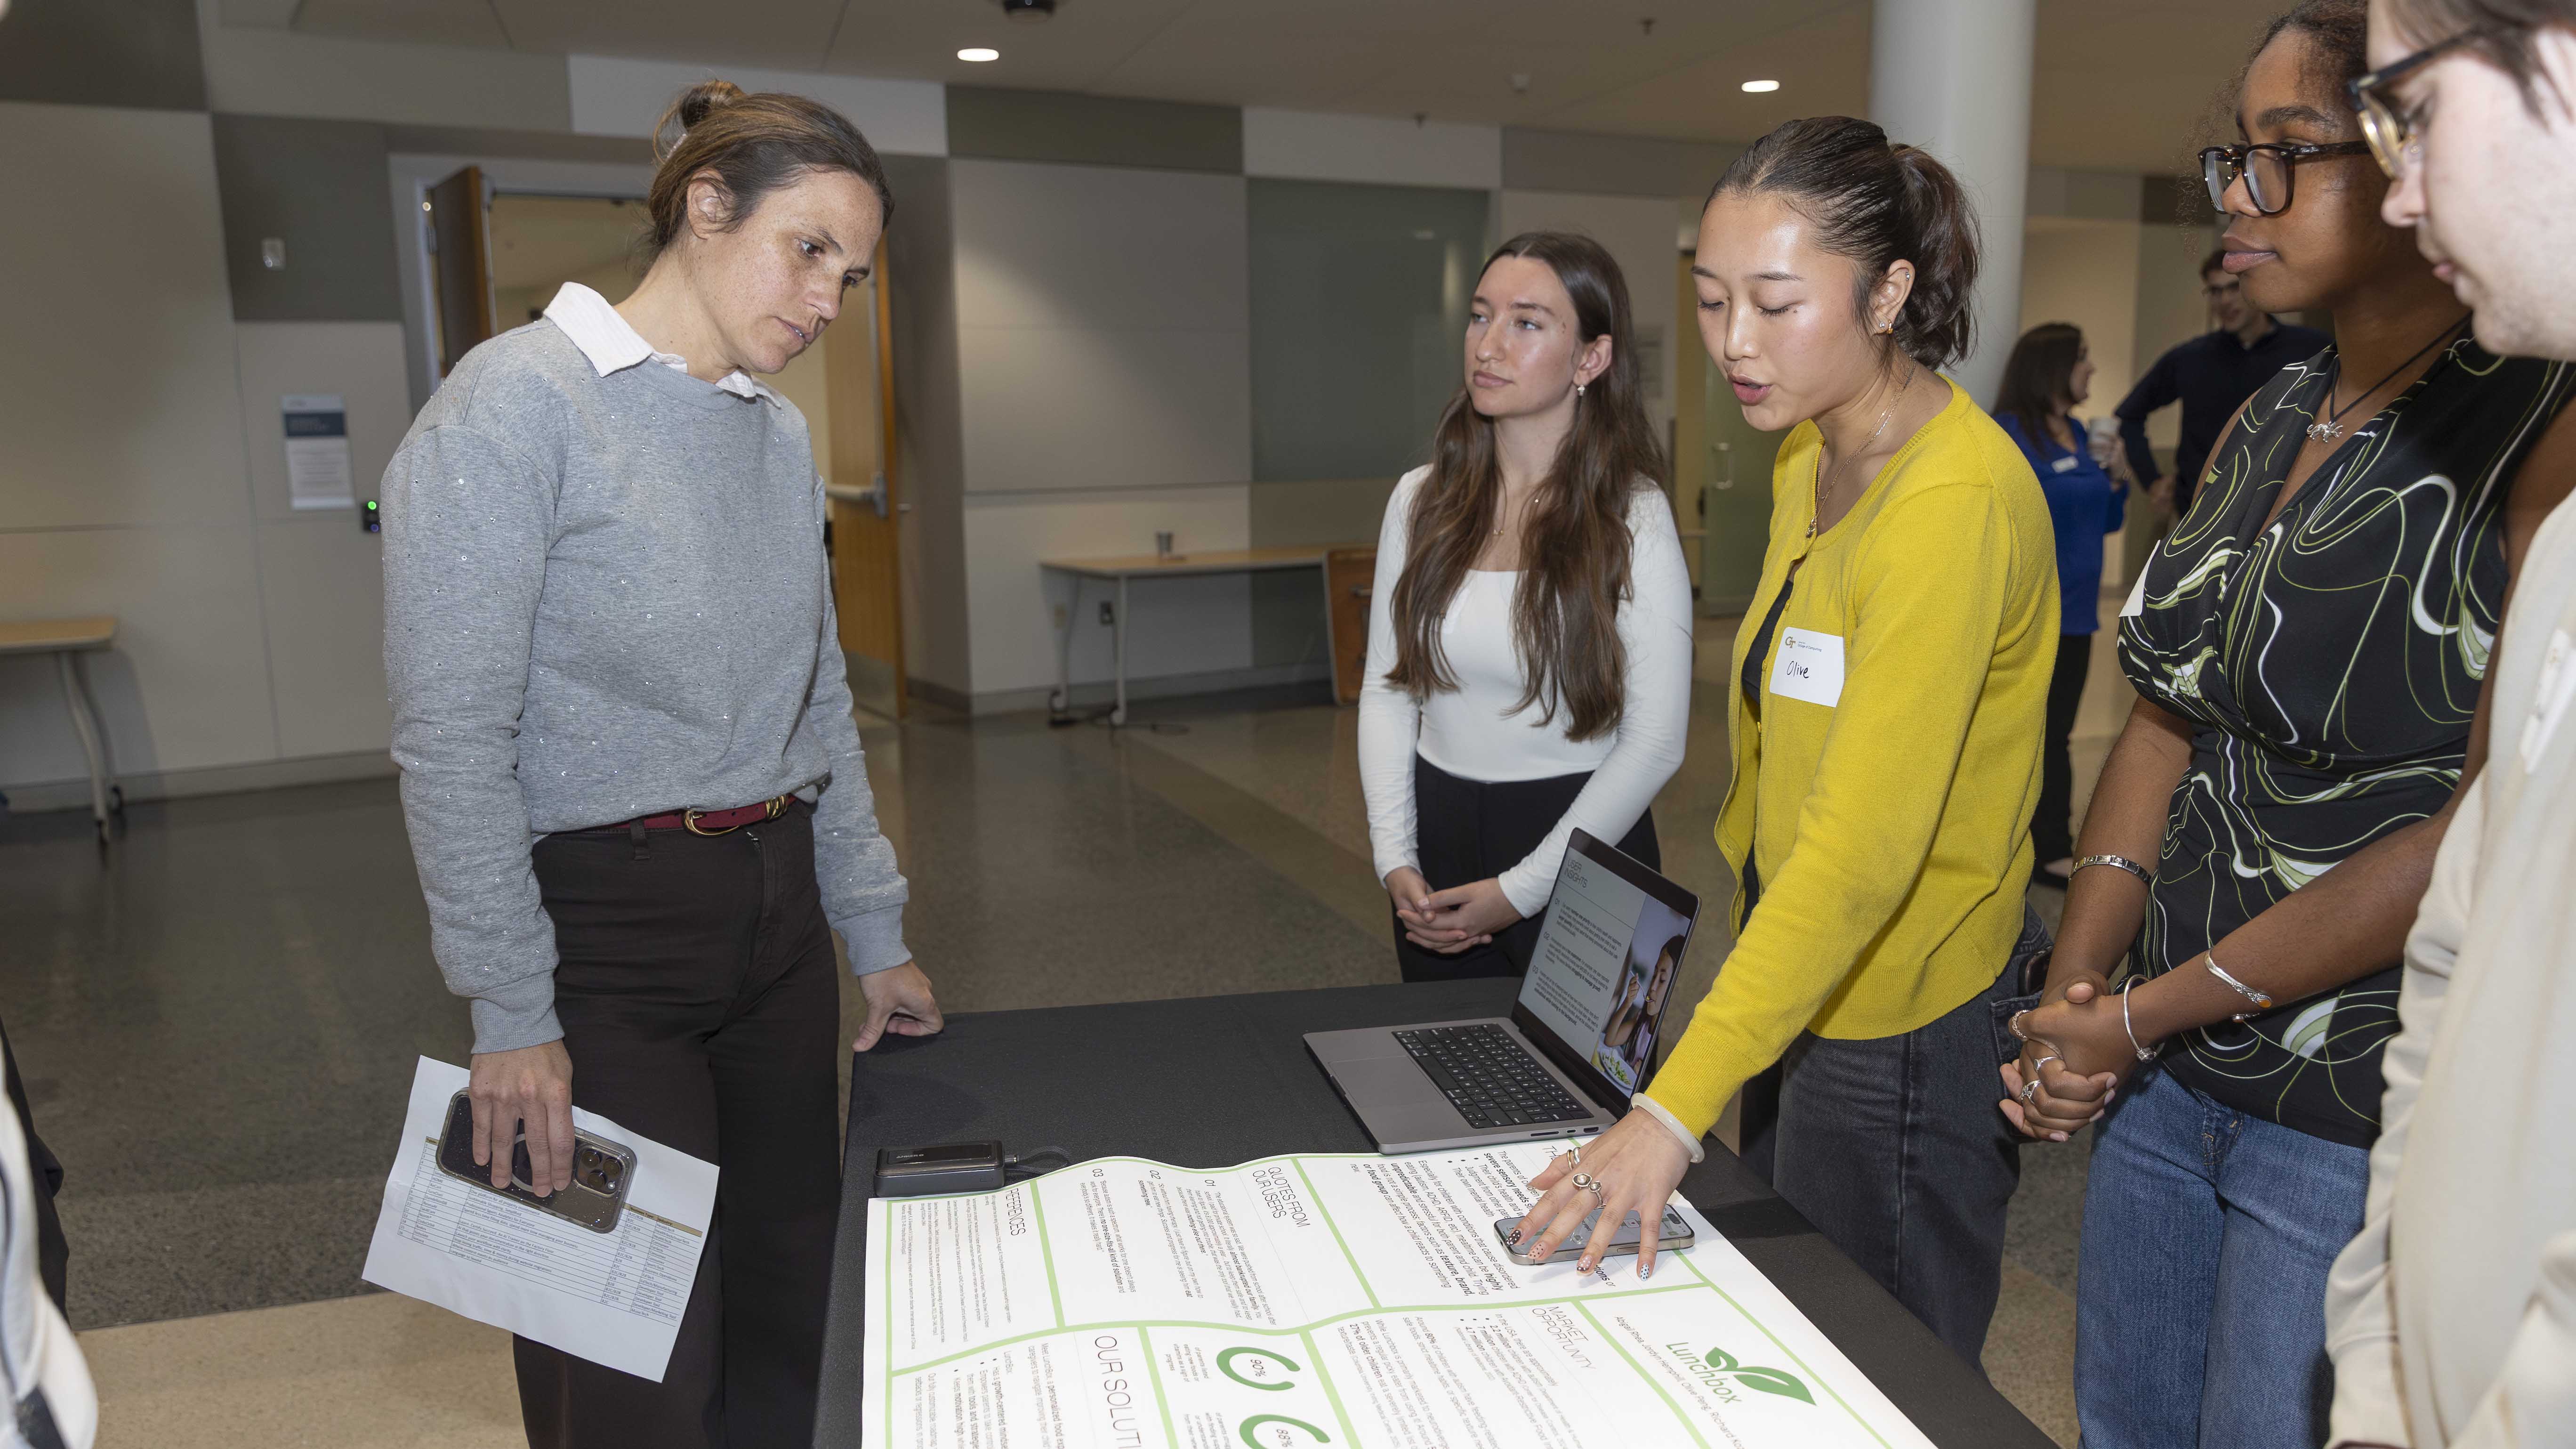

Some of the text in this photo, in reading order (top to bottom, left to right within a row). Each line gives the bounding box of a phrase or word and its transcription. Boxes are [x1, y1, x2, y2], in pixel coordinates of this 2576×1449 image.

[1785, 636, 1796, 648] GT
[1787, 661, 1810, 679] Olive
[1568, 858, 1582, 871] USER
[1564, 869, 1588, 888] INSIGHTS
[1543, 932, 1550, 940] 02
[1497, 1150, 1508, 1159] The
[1503, 1159, 1521, 1175] parents
[1366, 1169, 1382, 1180] food
[1390, 1163, 1418, 1194] unpredictable
[1483, 1152, 1529, 1203] severe sensory needs
[1137, 1180, 1149, 1198] something
[1253, 1170, 1287, 1218] OUR USERS
[1372, 1180, 1389, 1194] group
[1452, 1166, 1495, 1217] Their own mental health
[1465, 1166, 1513, 1219] Judgment from other pare
[1478, 1164, 1523, 1212] Their child's health and
[1268, 1167, 1311, 1227] QUOTES FROM
[1383, 1194, 1394, 1203] can
[1411, 1194, 1426, 1203] and
[1004, 1188, 1026, 1236] REFERENCES
[1388, 1203, 1404, 1215] affect
[1418, 1203, 1439, 1221] stressful
[1397, 1215, 1410, 1225] how
[1404, 1161, 1418, 1174] eating
[1455, 1234, 1476, 1255] mealtime
[1471, 1255, 1484, 1265] can
[1483, 1273, 1503, 1291] highly
[1417, 1160, 1439, 1181] Especially
[1437, 1187, 1455, 1205] children
[1449, 1204, 1464, 1214] with
[1457, 1214, 1479, 1238] conditions
[1473, 1238, 1488, 1247] that
[1481, 1247, 1497, 1263] cause
[1492, 1263, 1520, 1289] disordered
[1376, 1163, 1390, 1173] food
[1393, 1188, 1409, 1202] simple
[1415, 1221, 1432, 1236] factors
[1426, 1236, 1441, 1247] such
[1439, 1255, 1459, 1276] texture,
[1454, 1277, 1475, 1296] brand,
[1407, 1229, 1422, 1240] child
[1436, 1228, 1450, 1239] both
[1414, 1240, 1430, 1255] reacts
[1442, 1239, 1461, 1255] parent
[1455, 1254, 1470, 1264] and
[1428, 1262, 1452, 1288] something
[1472, 1279, 1489, 1295] Trying
[1546, 1306, 1589, 1341] MARKET
[1532, 1308, 1596, 1369] OPPORTUNITY
[1095, 1336, 1123, 1375] OUR
[1250, 1359, 1267, 1376] 90%
[1666, 1342, 1742, 1403] Lunchbox
[1276, 1429, 1294, 1447] 88%
